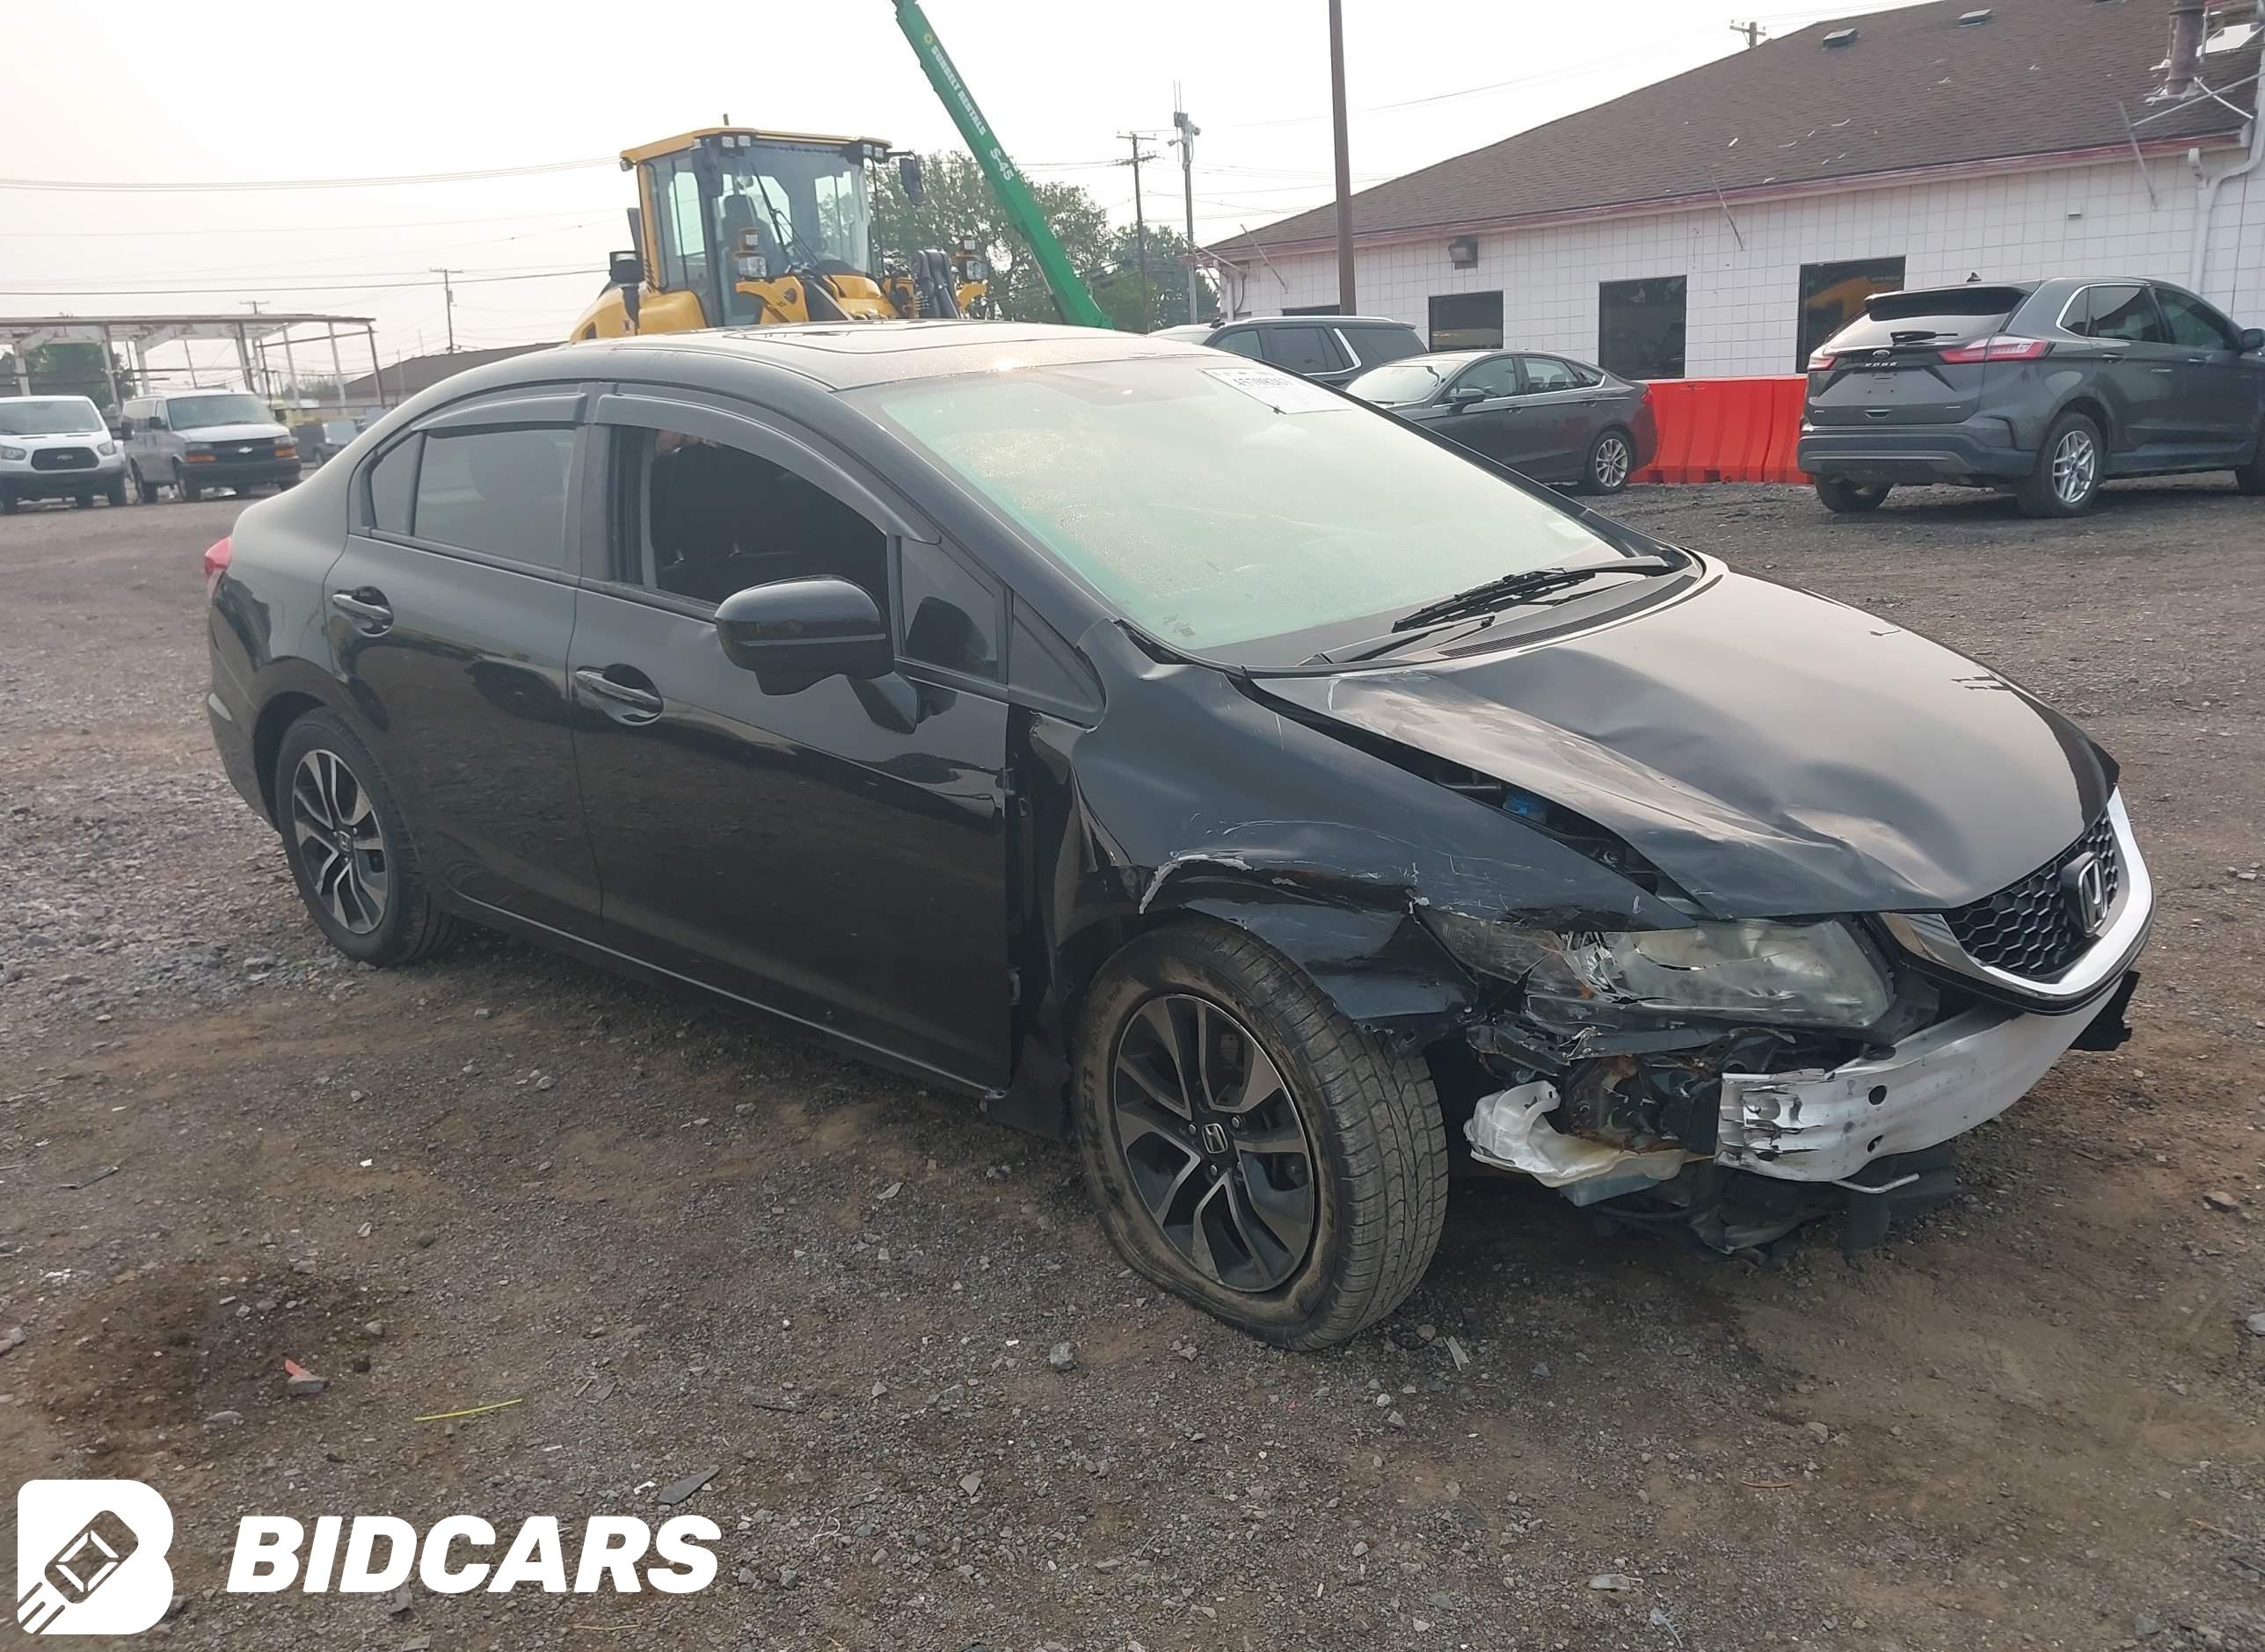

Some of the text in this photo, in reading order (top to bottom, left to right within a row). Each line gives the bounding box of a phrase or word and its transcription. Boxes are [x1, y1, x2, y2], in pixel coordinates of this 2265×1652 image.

[930, 45, 987, 136] SUNBELT RENTALS
[989, 147, 1015, 181] S-45
